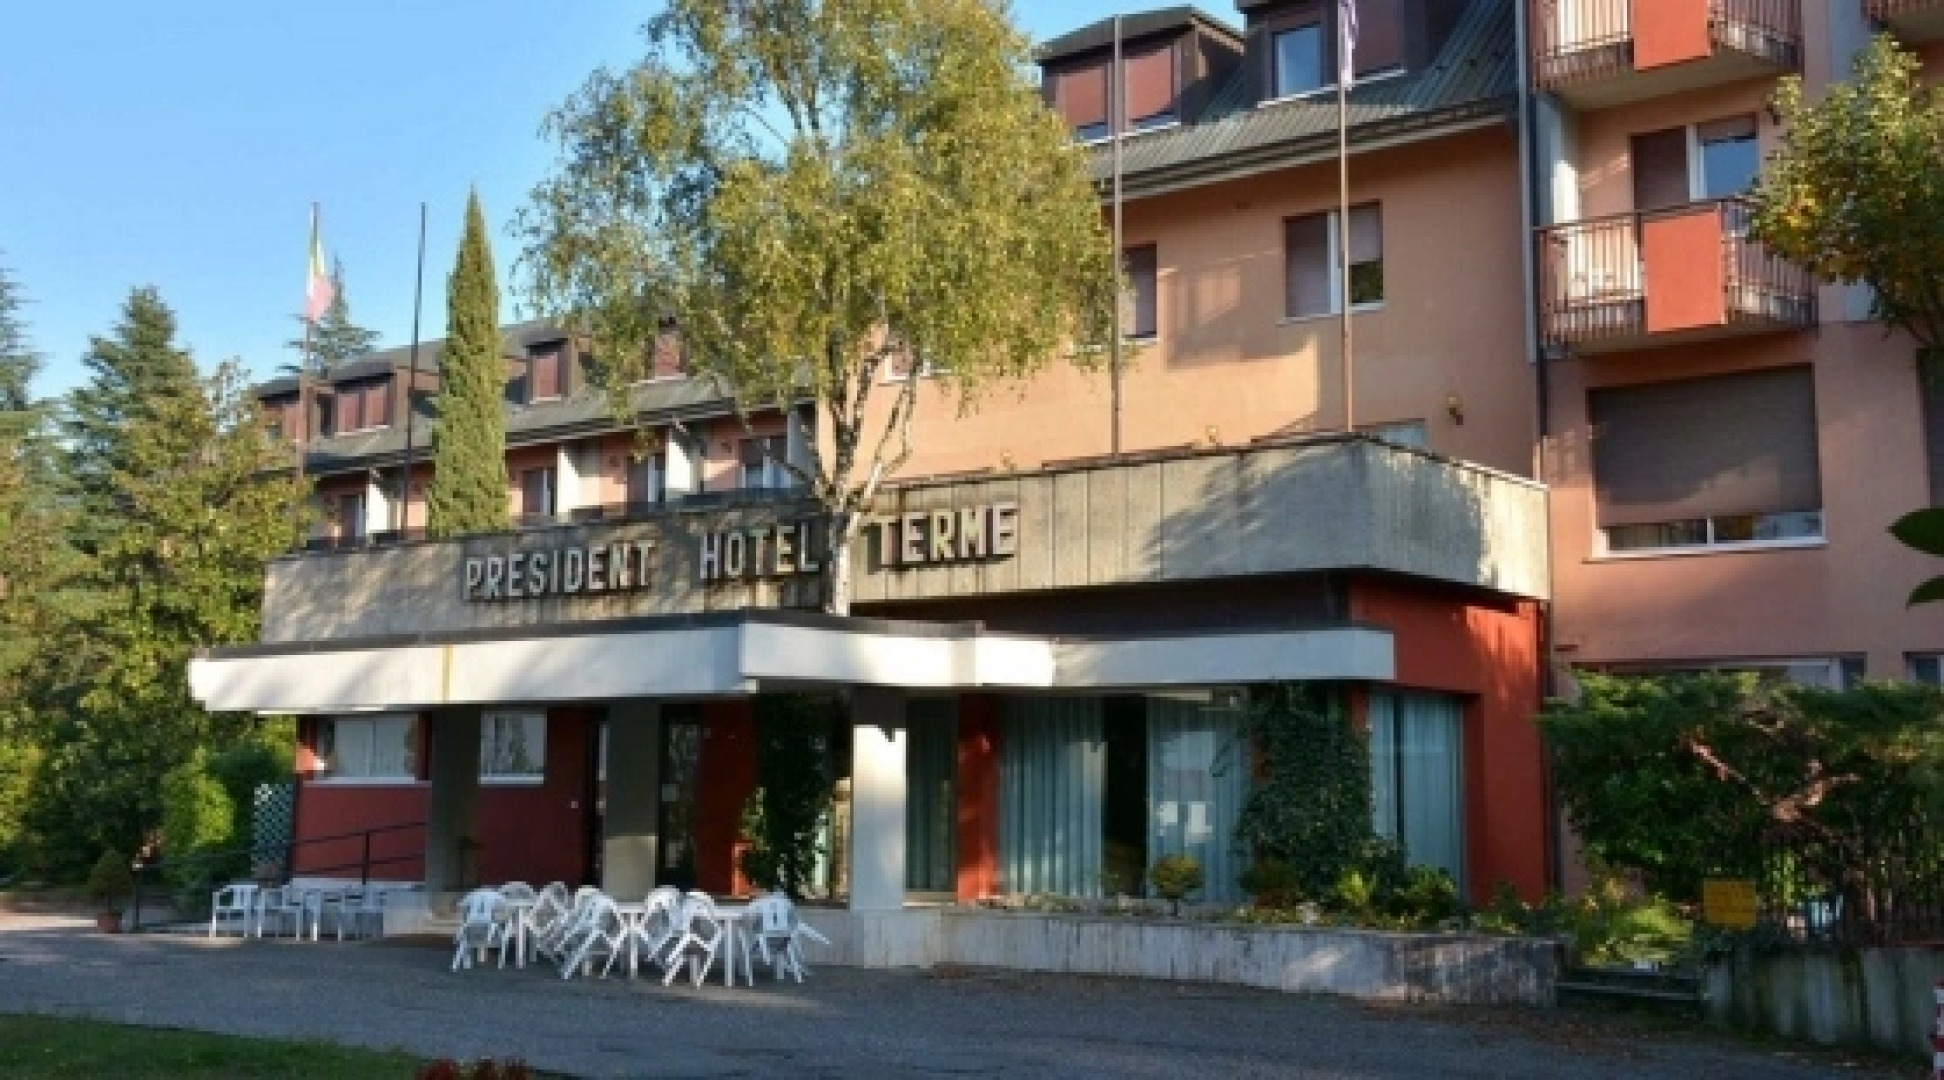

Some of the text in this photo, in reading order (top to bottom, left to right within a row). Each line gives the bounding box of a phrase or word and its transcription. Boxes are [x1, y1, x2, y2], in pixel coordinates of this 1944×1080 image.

[465, 502, 1019, 600] PRESIDENT HOTEL TERME
